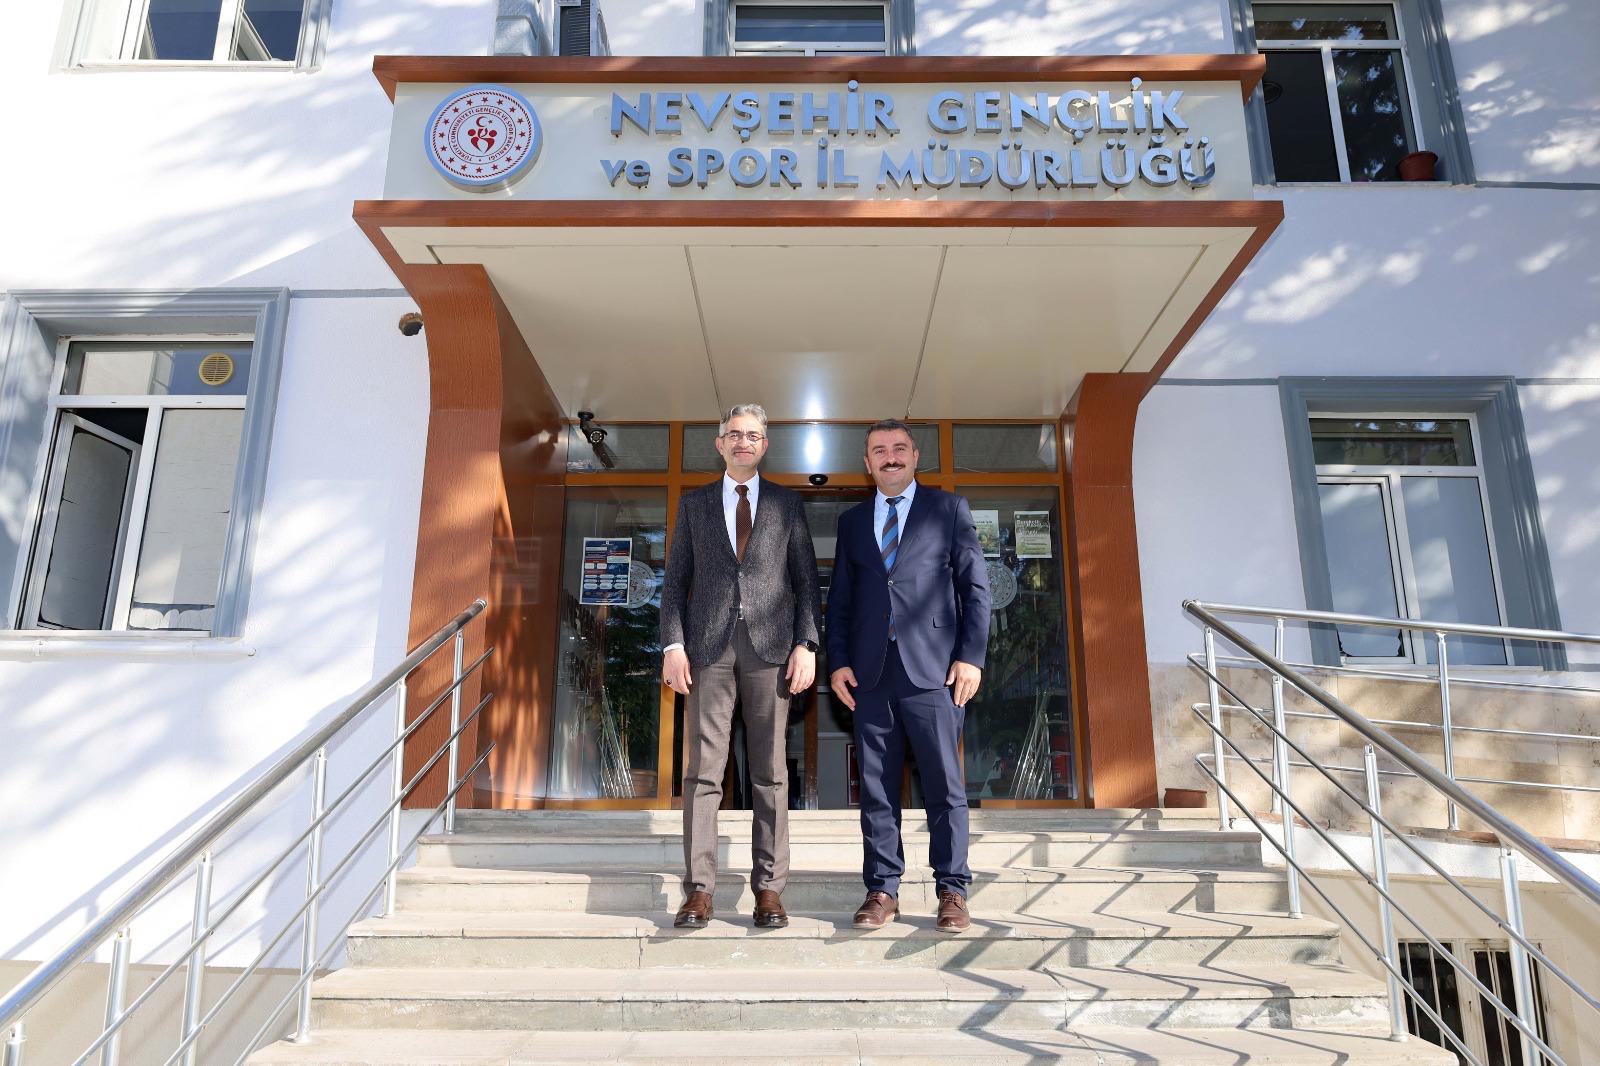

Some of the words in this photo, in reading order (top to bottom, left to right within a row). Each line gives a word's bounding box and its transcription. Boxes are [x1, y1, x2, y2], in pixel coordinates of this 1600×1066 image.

[611, 79, 900, 142] NEVŞEHİR
[927, 77, 1189, 144] GENÇLİK
[600, 159, 650, 188] ve
[667, 147, 801, 188] SPOR
[817, 137, 858, 188] İL
[876, 135, 1216, 189] MÜDÜRLÜĞÜ
